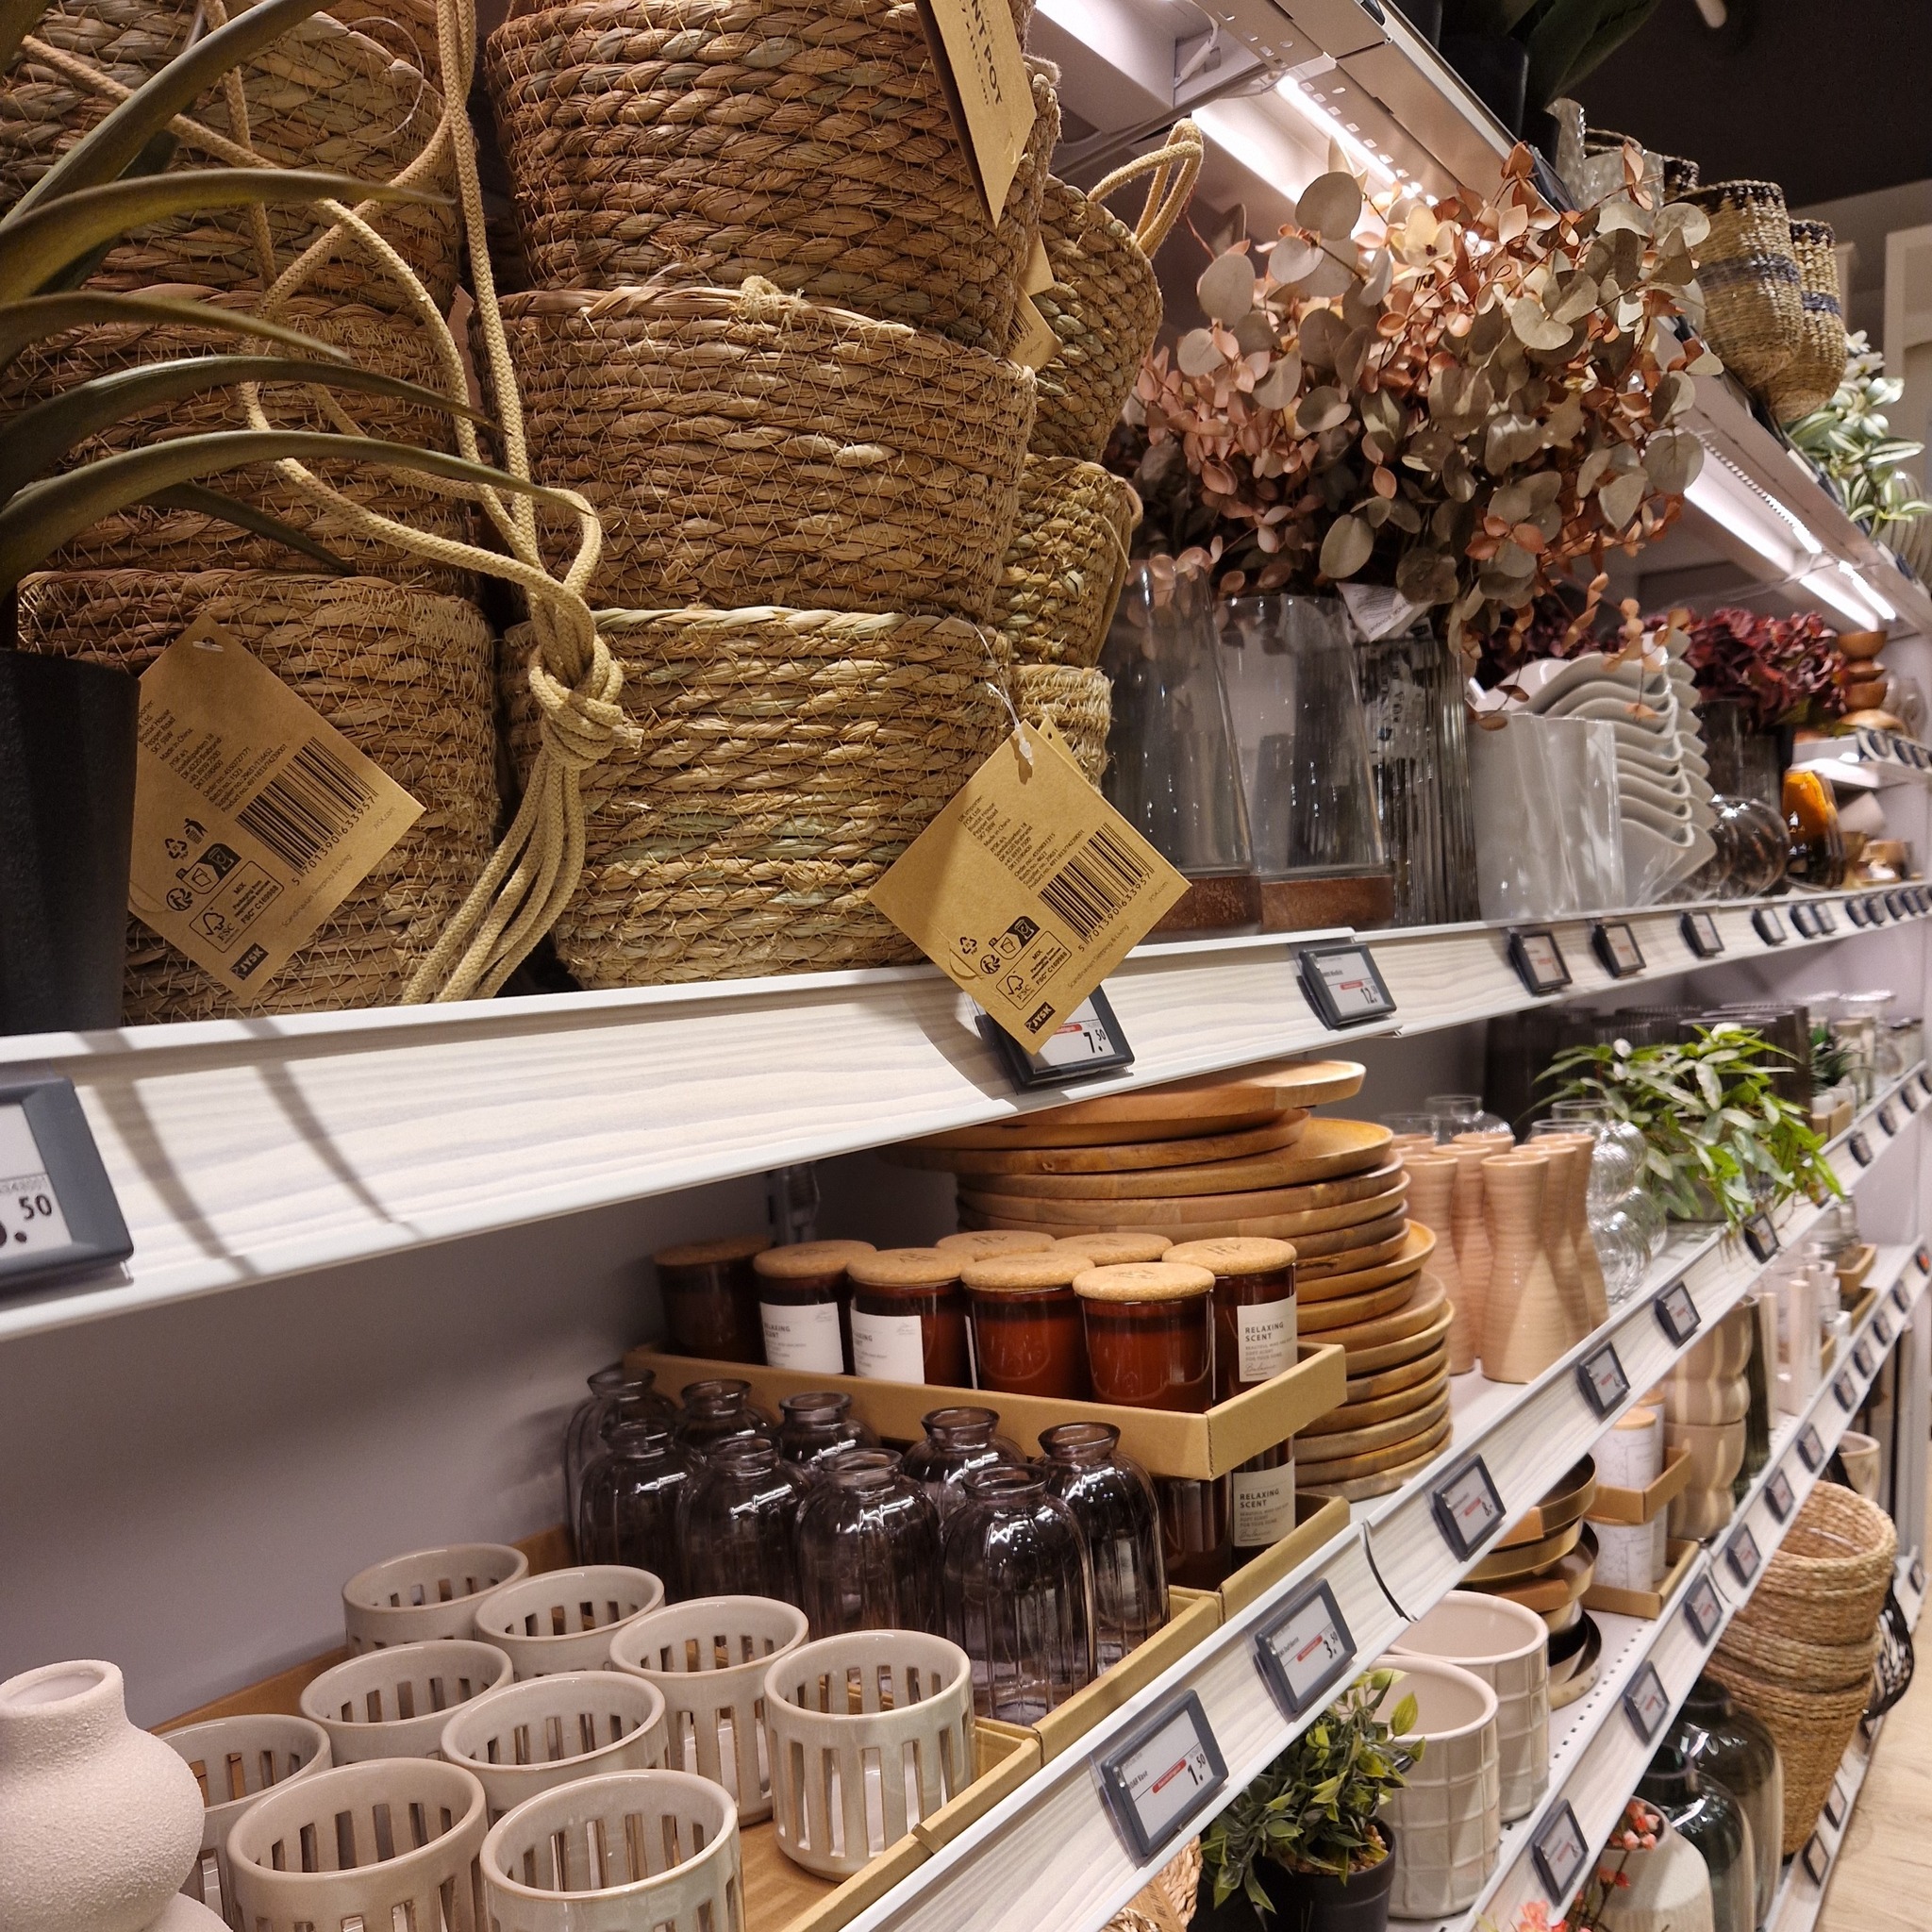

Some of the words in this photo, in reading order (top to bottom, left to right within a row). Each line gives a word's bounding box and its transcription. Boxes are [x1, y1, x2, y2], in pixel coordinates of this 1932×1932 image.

[984, 44, 1002, 105] POT
[154, 708, 170, 725] House
[143, 728, 163, 748] Pepper
[159, 715, 175, 731] Road
[159, 745, 174, 760] Made
[168, 755, 181, 768] JYSK
[203, 782, 217, 797] Order
[209, 787, 224, 802] Batch
[215, 788, 235, 808] Supplier
[222, 793, 241, 813] Product
[963, 815, 973, 826] JYSK
[968, 815, 982, 831] Biostat
[981, 802, 994, 817] House
[973, 820, 988, 836] Pepper
[986, 808, 998, 821] Road
[302, 835, 340, 874] 701390
[340, 795, 375, 834] 633957
[983, 834, 994, 846] Made
[990, 841, 999, 852] JYSK
[334, 852, 353, 871] Living
[1014, 864, 1025, 876] Order
[1019, 868, 1030, 881] Batch
[1024, 868, 1040, 886] Supplier
[233, 882, 245, 894] MIX
[1028, 873, 1043, 890] Product
[1088, 907, 1119, 941] 701390
[1120, 872, 1151, 907] 633957
[217, 923, 235, 941] FSC
[1113, 923, 1128, 940] Living
[240, 946, 263, 972] JYSK
[1032, 949, 1041, 959] MIX
[1017, 984, 1031, 999] FSC
[1031, 1005, 1051, 1026] JYSK
[1245, 1322, 1284, 1334] RELAXING
[1245, 1333, 1272, 1341] SCENT
[1240, 1489, 1280, 1500] RELAXING
[1240, 1500, 1267, 1508] SCENT
